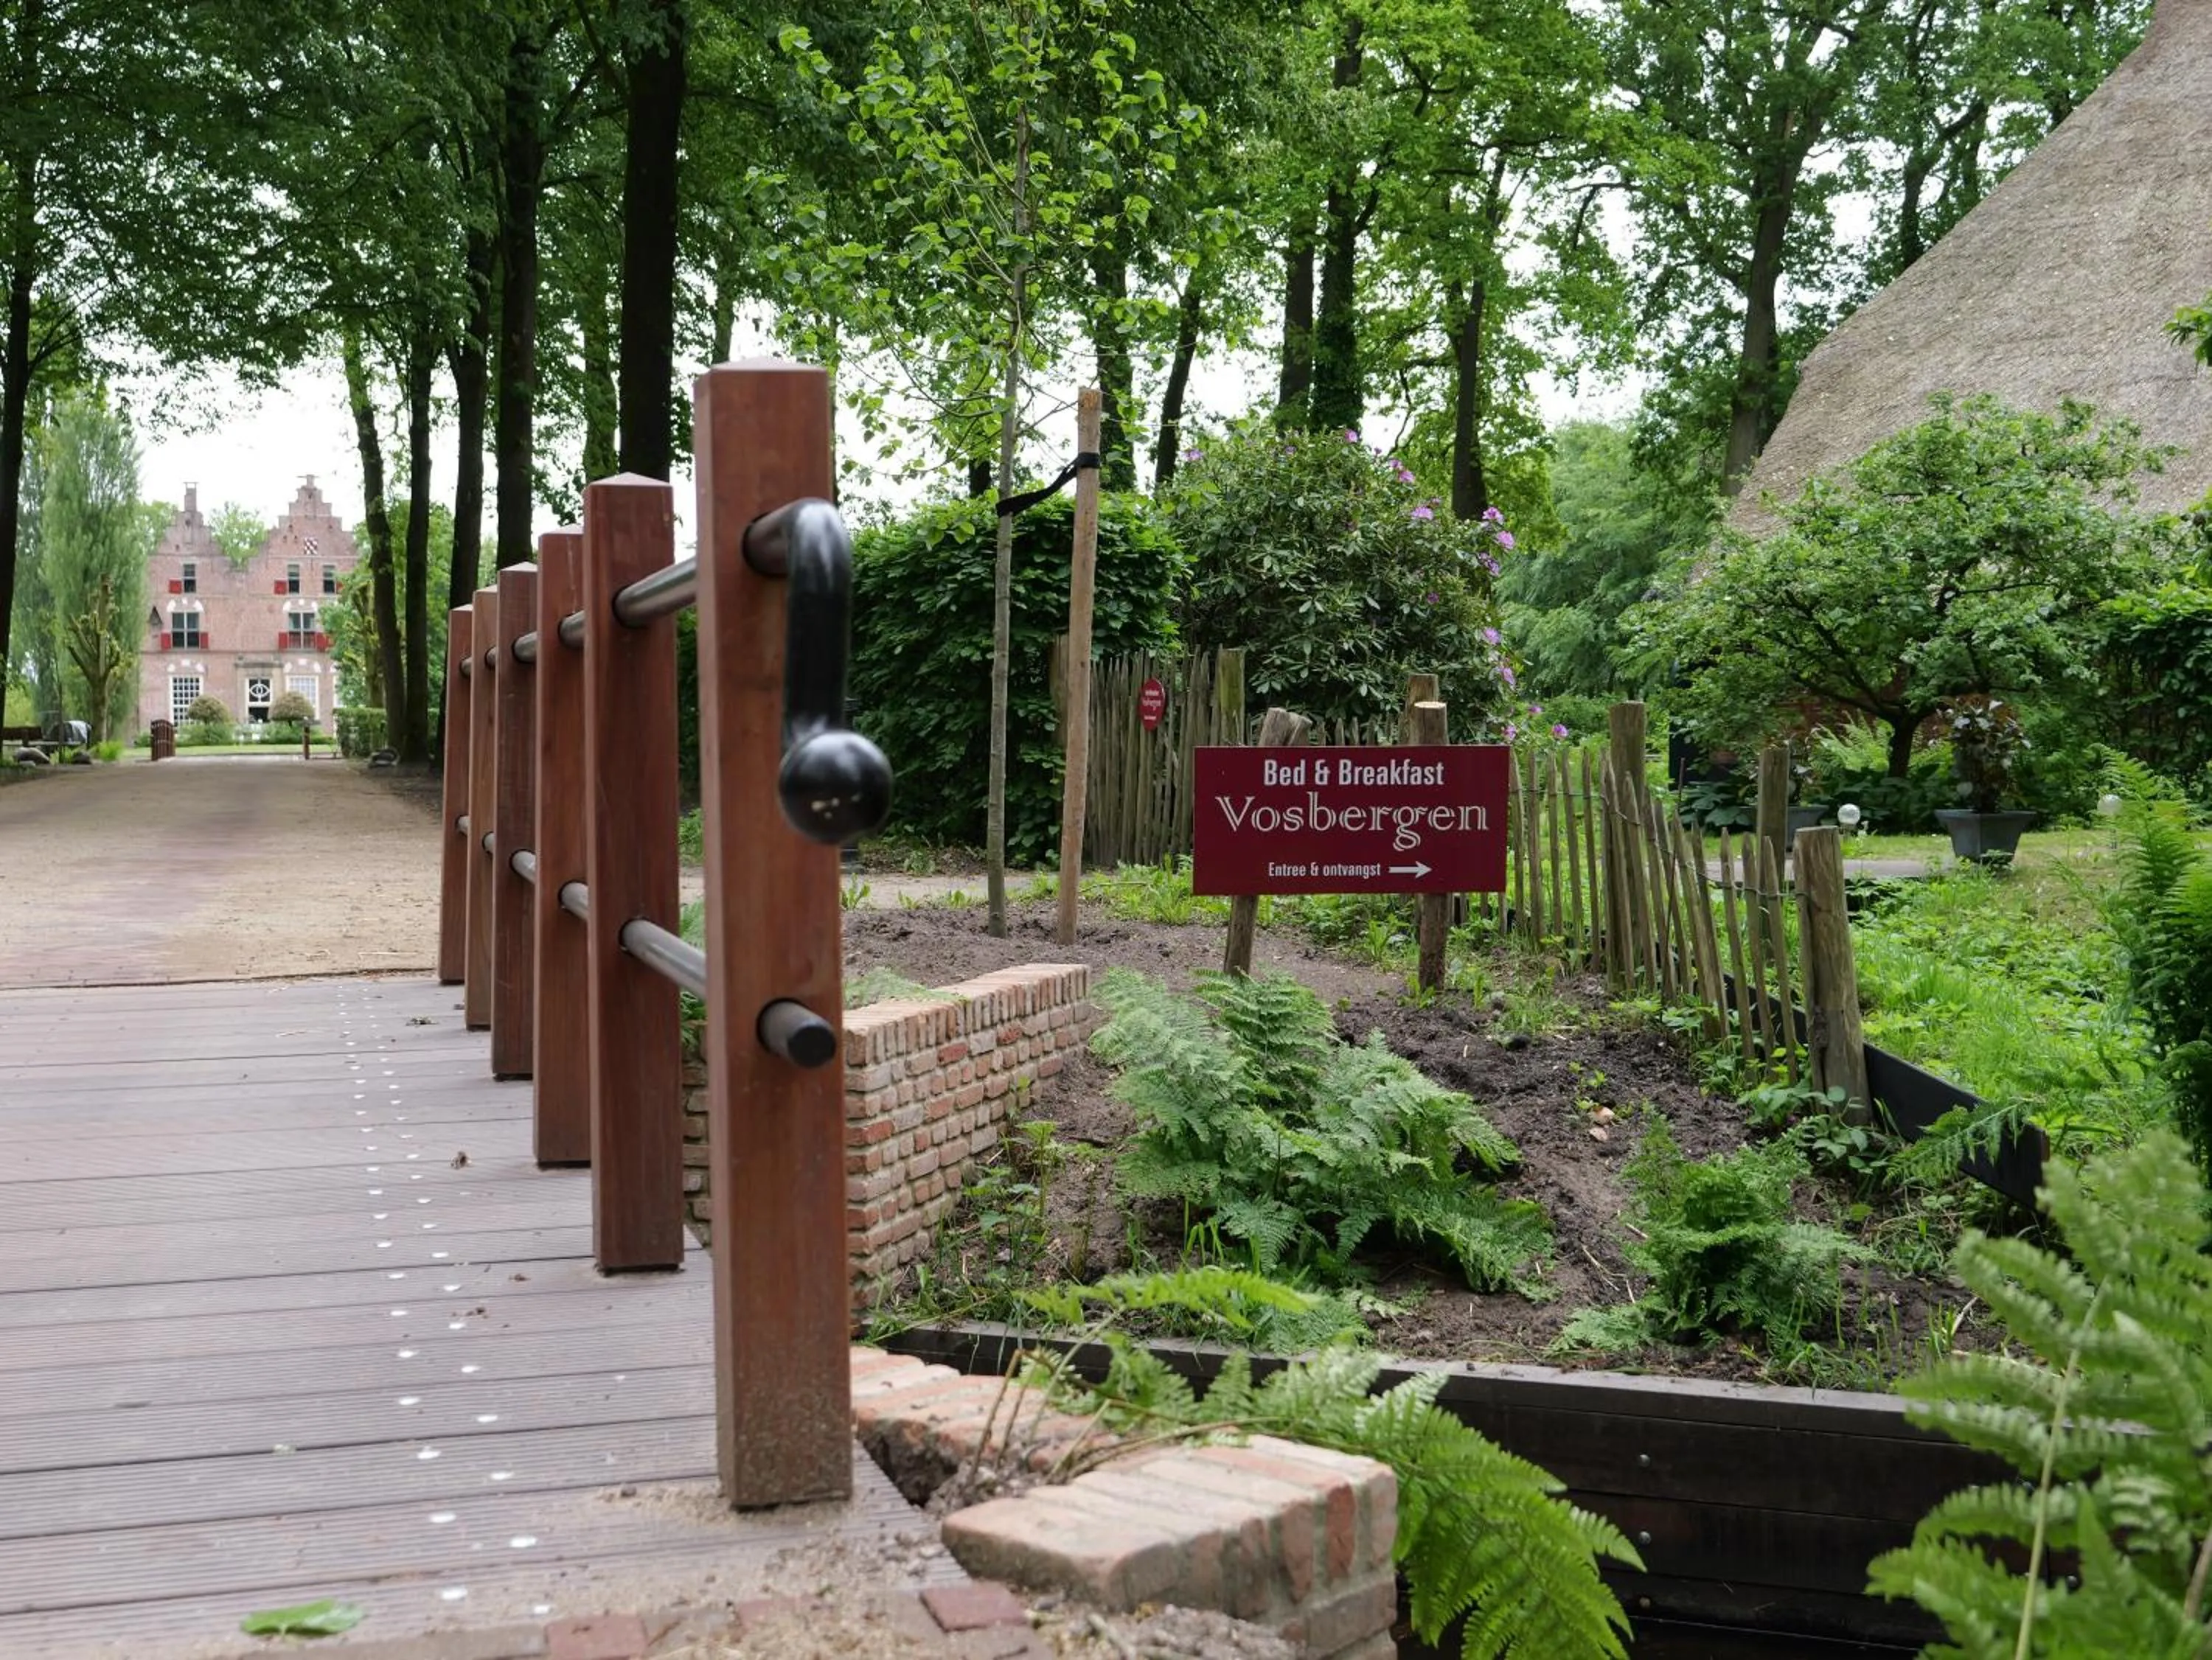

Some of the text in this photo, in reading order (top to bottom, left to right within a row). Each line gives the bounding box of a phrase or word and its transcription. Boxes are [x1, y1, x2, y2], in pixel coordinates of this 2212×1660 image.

[1264, 758, 1444, 787] Bed & Breakfast
[1215, 791, 1489, 851] Vosbergen
[1268, 862, 1381, 880] Entree & ontvangst
